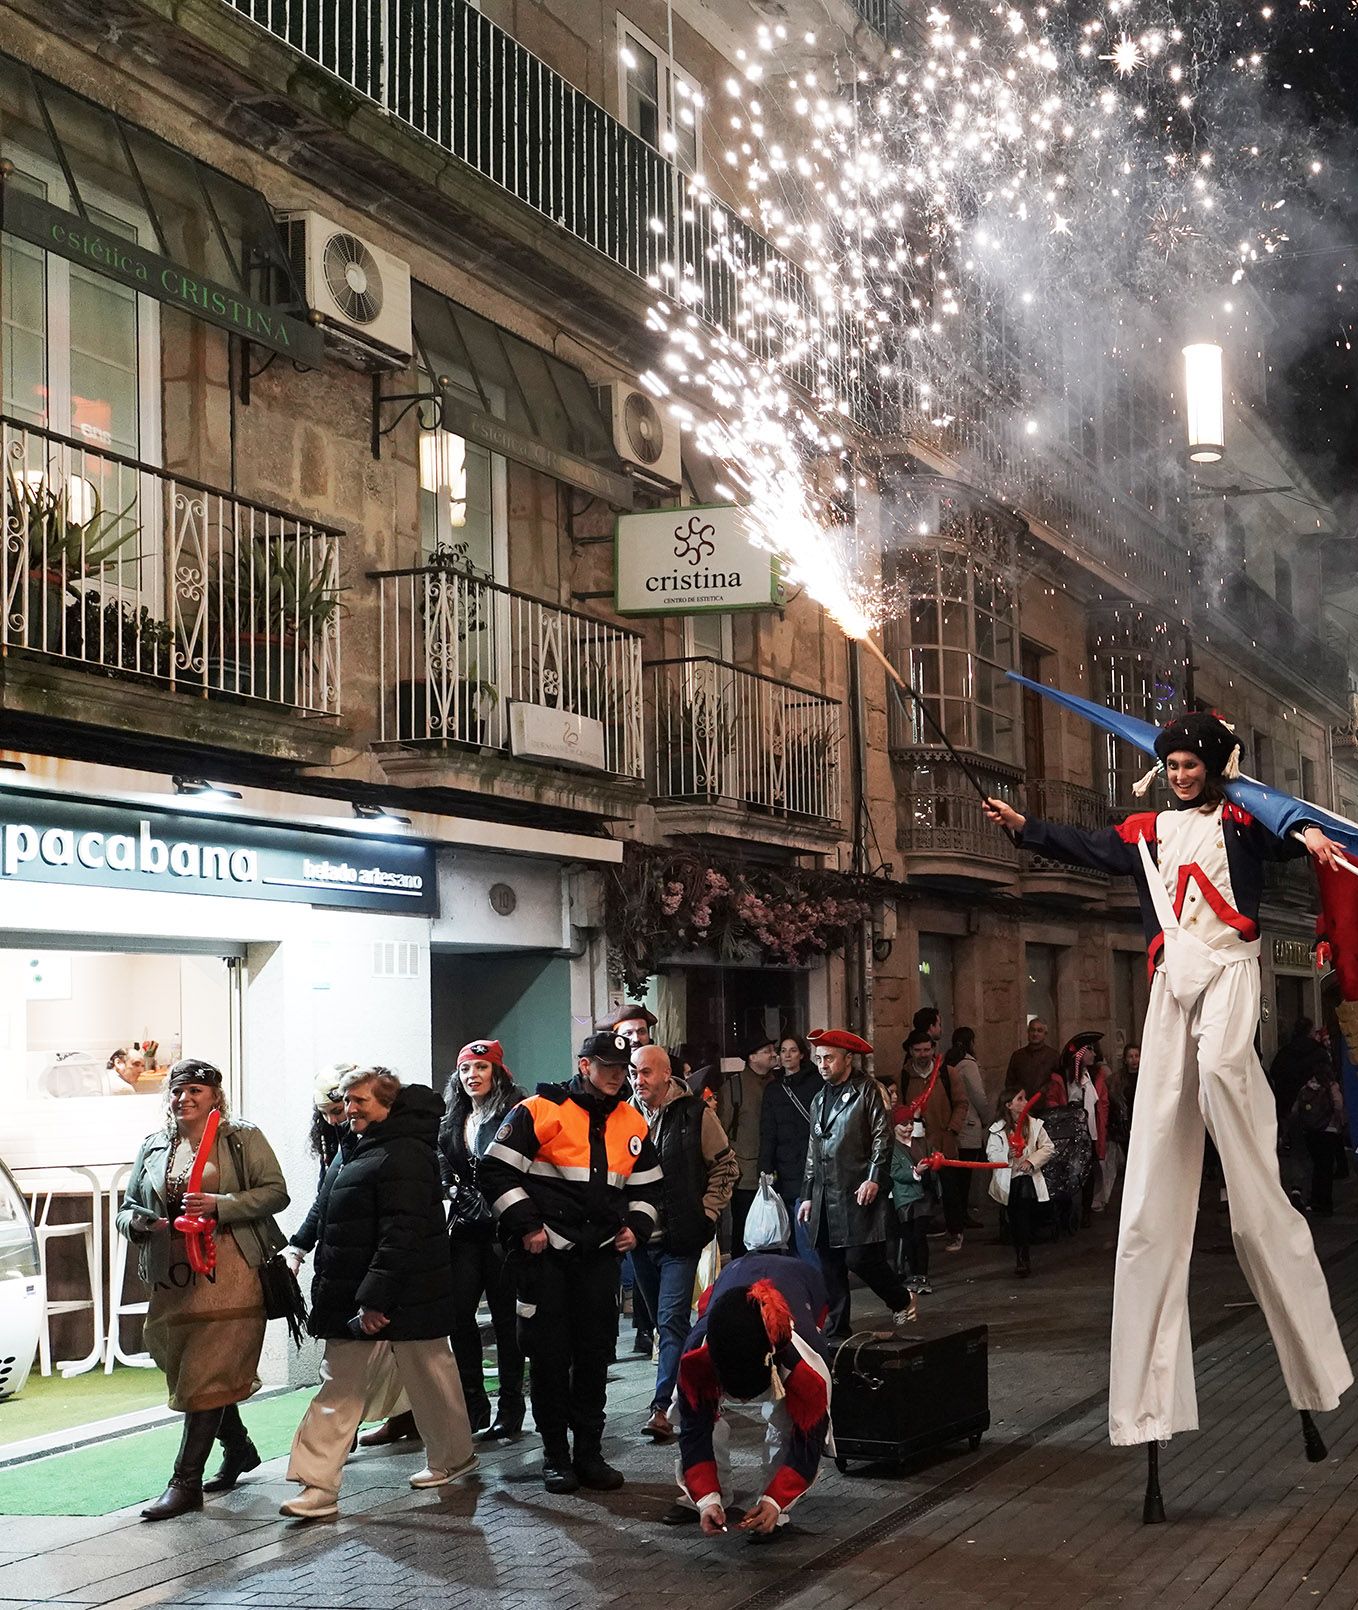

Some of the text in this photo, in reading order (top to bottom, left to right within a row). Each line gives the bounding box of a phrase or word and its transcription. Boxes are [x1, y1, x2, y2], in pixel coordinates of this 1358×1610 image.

[51, 222, 291, 347] estética CRISTINA
[646, 567, 742, 592] cristina
[2, 821, 258, 882] pacabana
[359, 867, 423, 889] artesano
